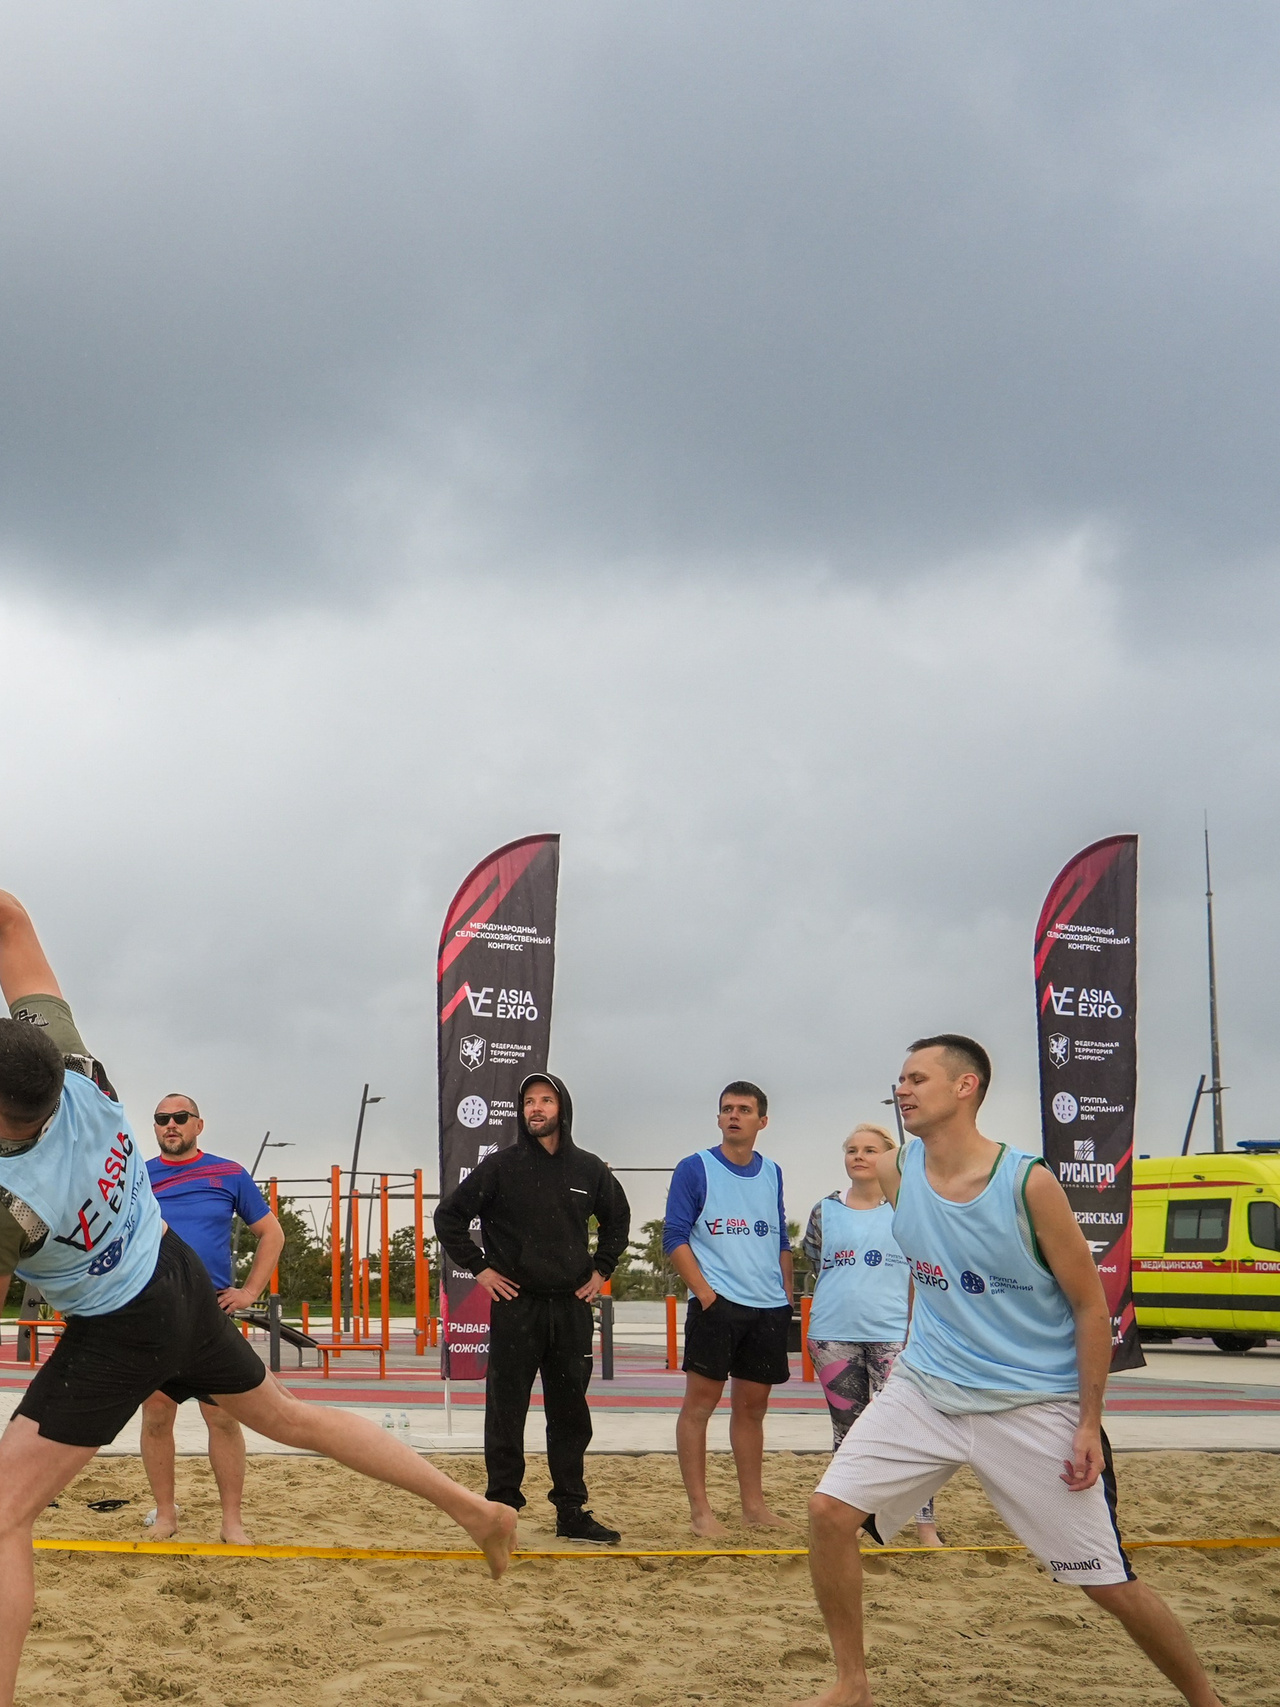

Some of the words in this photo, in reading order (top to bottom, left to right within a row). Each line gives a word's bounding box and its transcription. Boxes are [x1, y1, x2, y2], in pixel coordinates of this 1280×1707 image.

[470, 922, 537, 934] МЕЖДУНАРОДНЫЙ
[1055, 923, 1115, 935] МЕЖДУНАРОДНЫЙ
[455, 930, 551, 945] СЕЛЬСКОХОЗЯЙСТВЕННЫЙ
[1046, 930, 1131, 945] СЕЛЬСКОХОЗЯЙСТВЕННЫЙ
[487, 942, 524, 951] КОНГРЕСС
[1067, 942, 1101, 952] КОНГРЕСС
[497, 988, 534, 1006] ASIA
[1078, 988, 1116, 1004] ASIA
[496, 1004, 538, 1021] EXPO
[1078, 1003, 1123, 1019] EXPO
[490, 1042, 532, 1051] ФЕДЕРАЛЬНАЯ
[1074, 1040, 1120, 1048] ФЕДЕРАЛЬНАЯ
[490, 1049, 525, 1058] ТЕРРИТОРИЯ
[1074, 1047, 1114, 1055] ТЕРРИТОРИЯ
[490, 1100, 514, 1109] ГРУППА
[1080, 1096, 1108, 1104] ГРУППА
[1080, 1104, 1124, 1113] КОМПАНИЙ
[488, 1118, 503, 1126] ВИК
[1080, 1113, 1095, 1121] ВИК
[1059, 1162, 1115, 1183] РУСАГРО
[726, 1218, 747, 1227] ASIA
[726, 1226, 750, 1236] EXPO
[834, 1250, 855, 1259] ASIA
[916, 1260, 943, 1277] ASIA
[1140, 1260, 1204, 1270] МЕДИЦИНСКАЯ
[918, 1271, 949, 1291] EXPO
[989, 1275, 1018, 1284] ГРУППА
[989, 1282, 1034, 1291] КОМПАНИЙ
[1050, 1558, 1102, 1571] SPALDING
